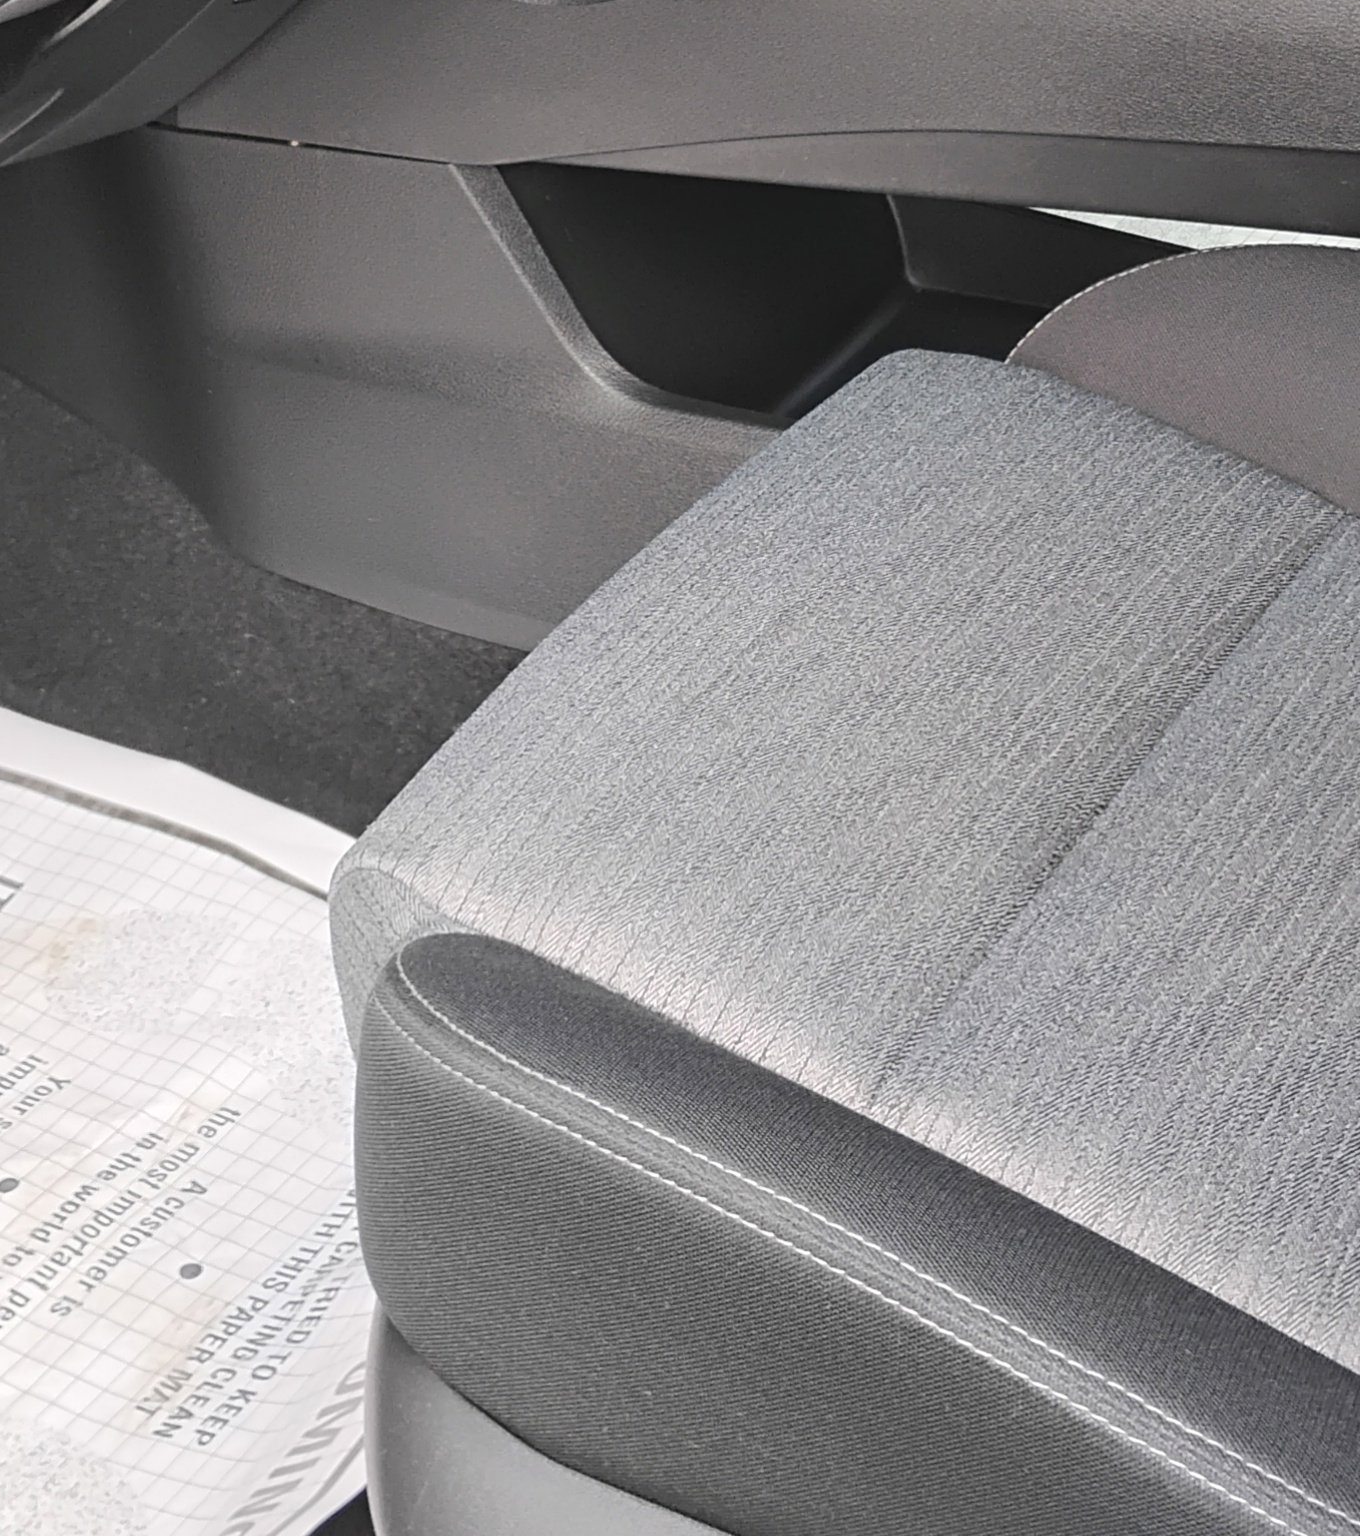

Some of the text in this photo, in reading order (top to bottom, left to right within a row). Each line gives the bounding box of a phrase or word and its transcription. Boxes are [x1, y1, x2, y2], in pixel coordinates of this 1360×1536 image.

[14, 1074, 72, 1117] Your
[135, 1130, 165, 1151] in
[196, 1105, 242, 1140] the
[96, 1151, 143, 1182] the
[138, 1142, 201, 1190] most
[28, 1183, 100, 1244] world
[0, 1244, 36, 1268] to
[26, 1187, 143, 1293] important
[49, 1179, 209, 1318] A customer is
[262, 1245, 325, 1294] THIS
[185, 1294, 270, 1366] PAPER
[251, 1350, 293, 1381] TO
[134, 1367, 195, 1418] MAT
[151, 1366, 239, 1440] CLEAN
[194, 1387, 258, 1448] KEEP
